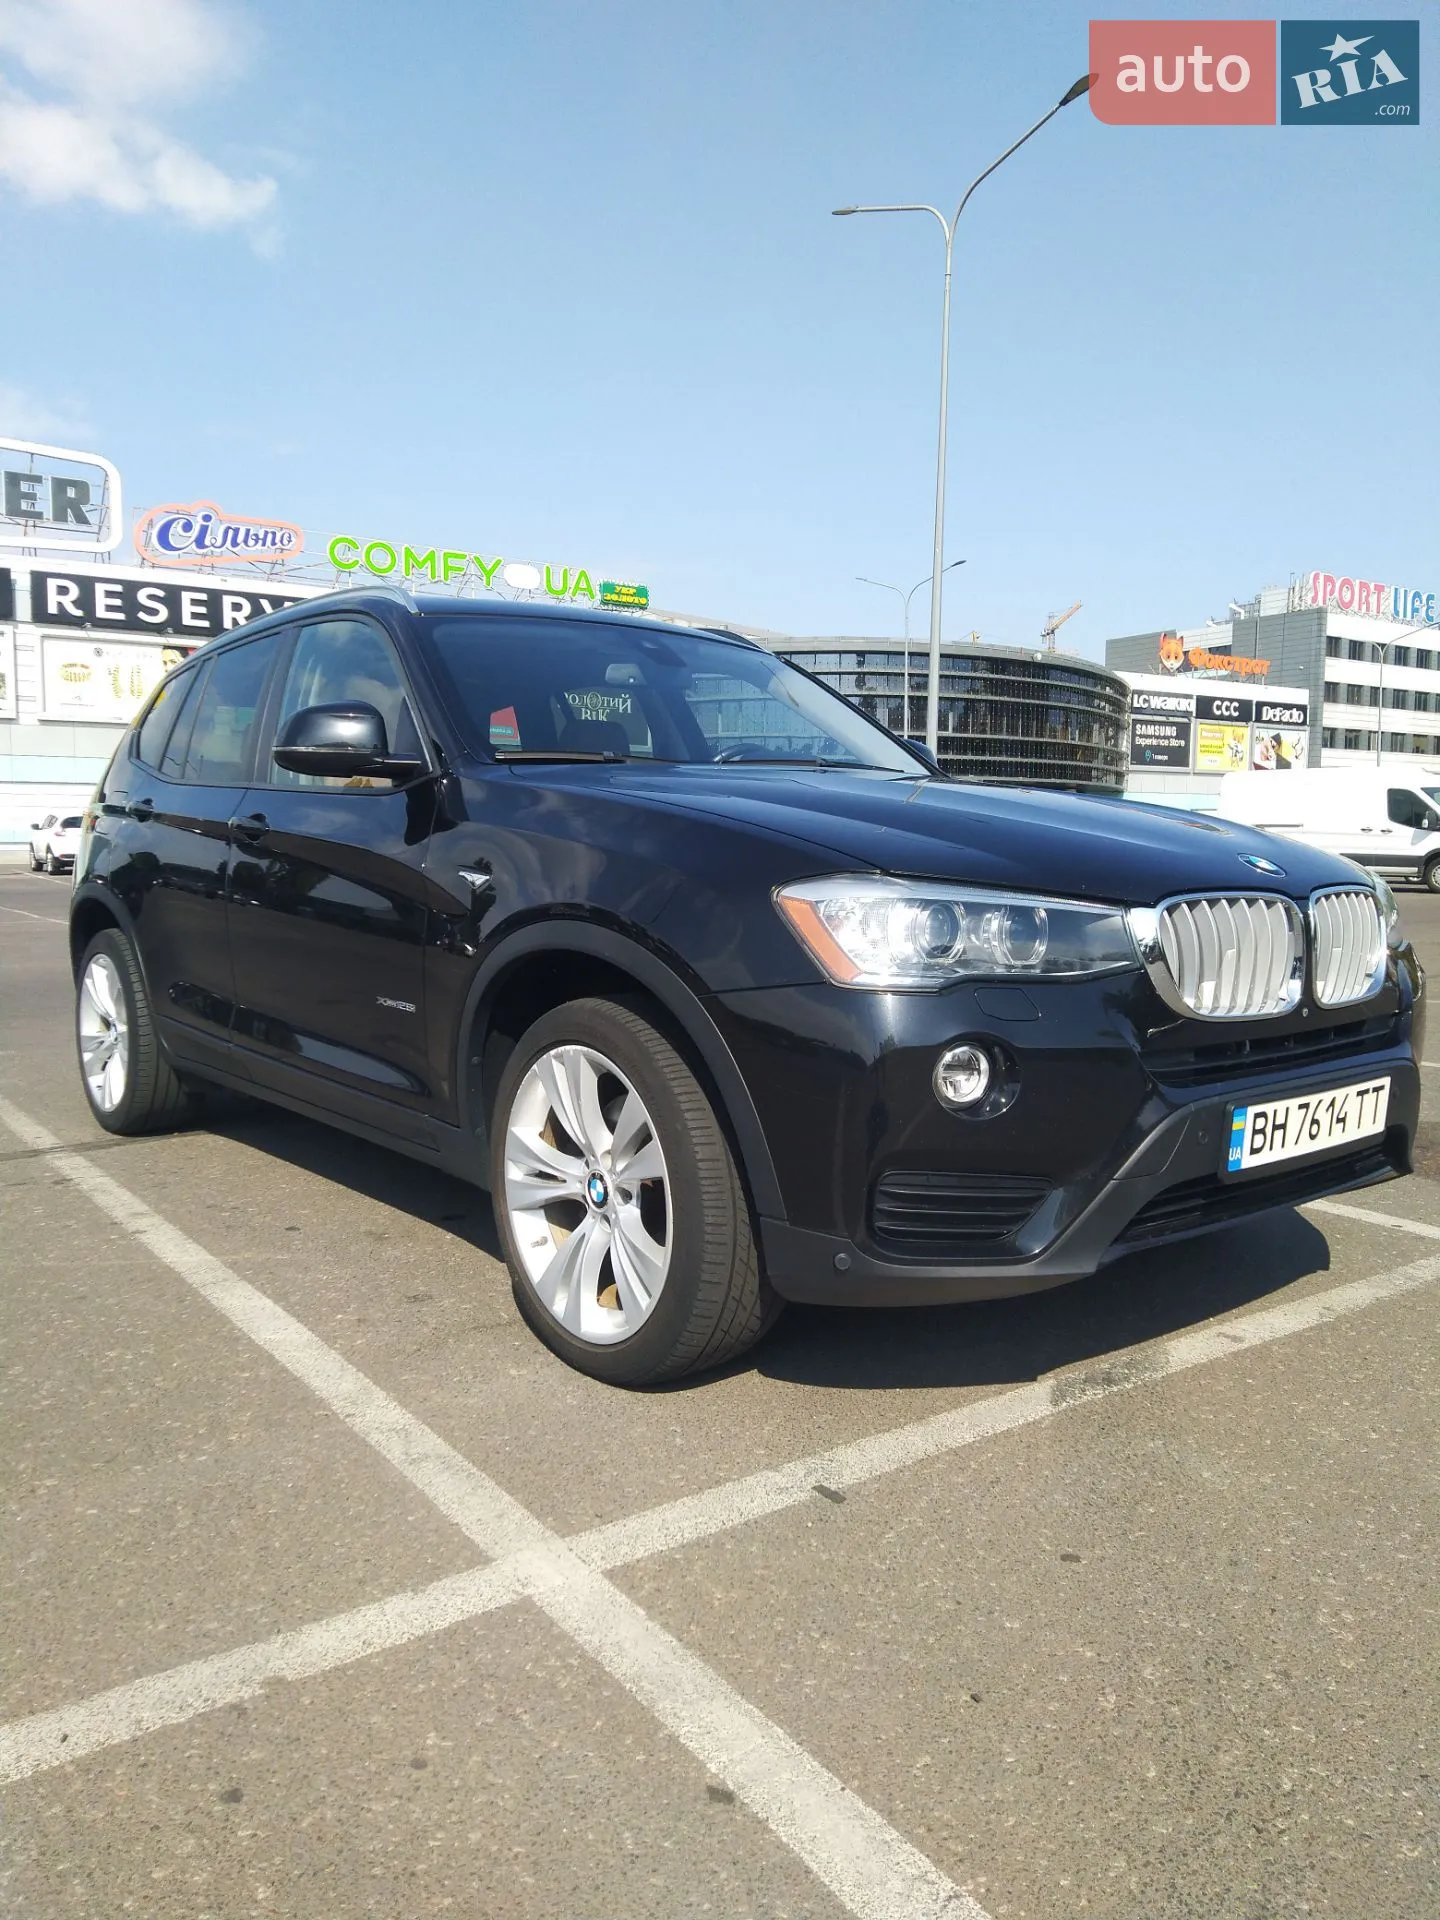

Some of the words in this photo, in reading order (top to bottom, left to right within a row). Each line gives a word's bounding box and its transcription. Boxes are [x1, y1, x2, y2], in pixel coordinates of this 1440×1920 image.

[155, 512, 294, 552] Сільпо
[327, 535, 503, 588] COMFY
[544, 564, 596, 600] UA
[1310, 571, 1386, 616] SPORT
[1392, 586, 1436, 623] LIFE
[1188, 647, 1271, 676] Фокстрот
[563, 691, 632, 713] ОЛОТИЙ
[1213, 700, 1240, 717] CCC
[1262, 706, 1304, 723] DeFacto
[1135, 723, 1177, 737] SAMSUNG
[1135, 736, 1169, 747] Experience
[1169, 738, 1186, 747] Store
[1249, 1106, 1290, 1156] BH
[1294, 1093, 1350, 1145] 7614
[1356, 1084, 1386, 1129] TT
[1228, 1148, 1241, 1161] UA
